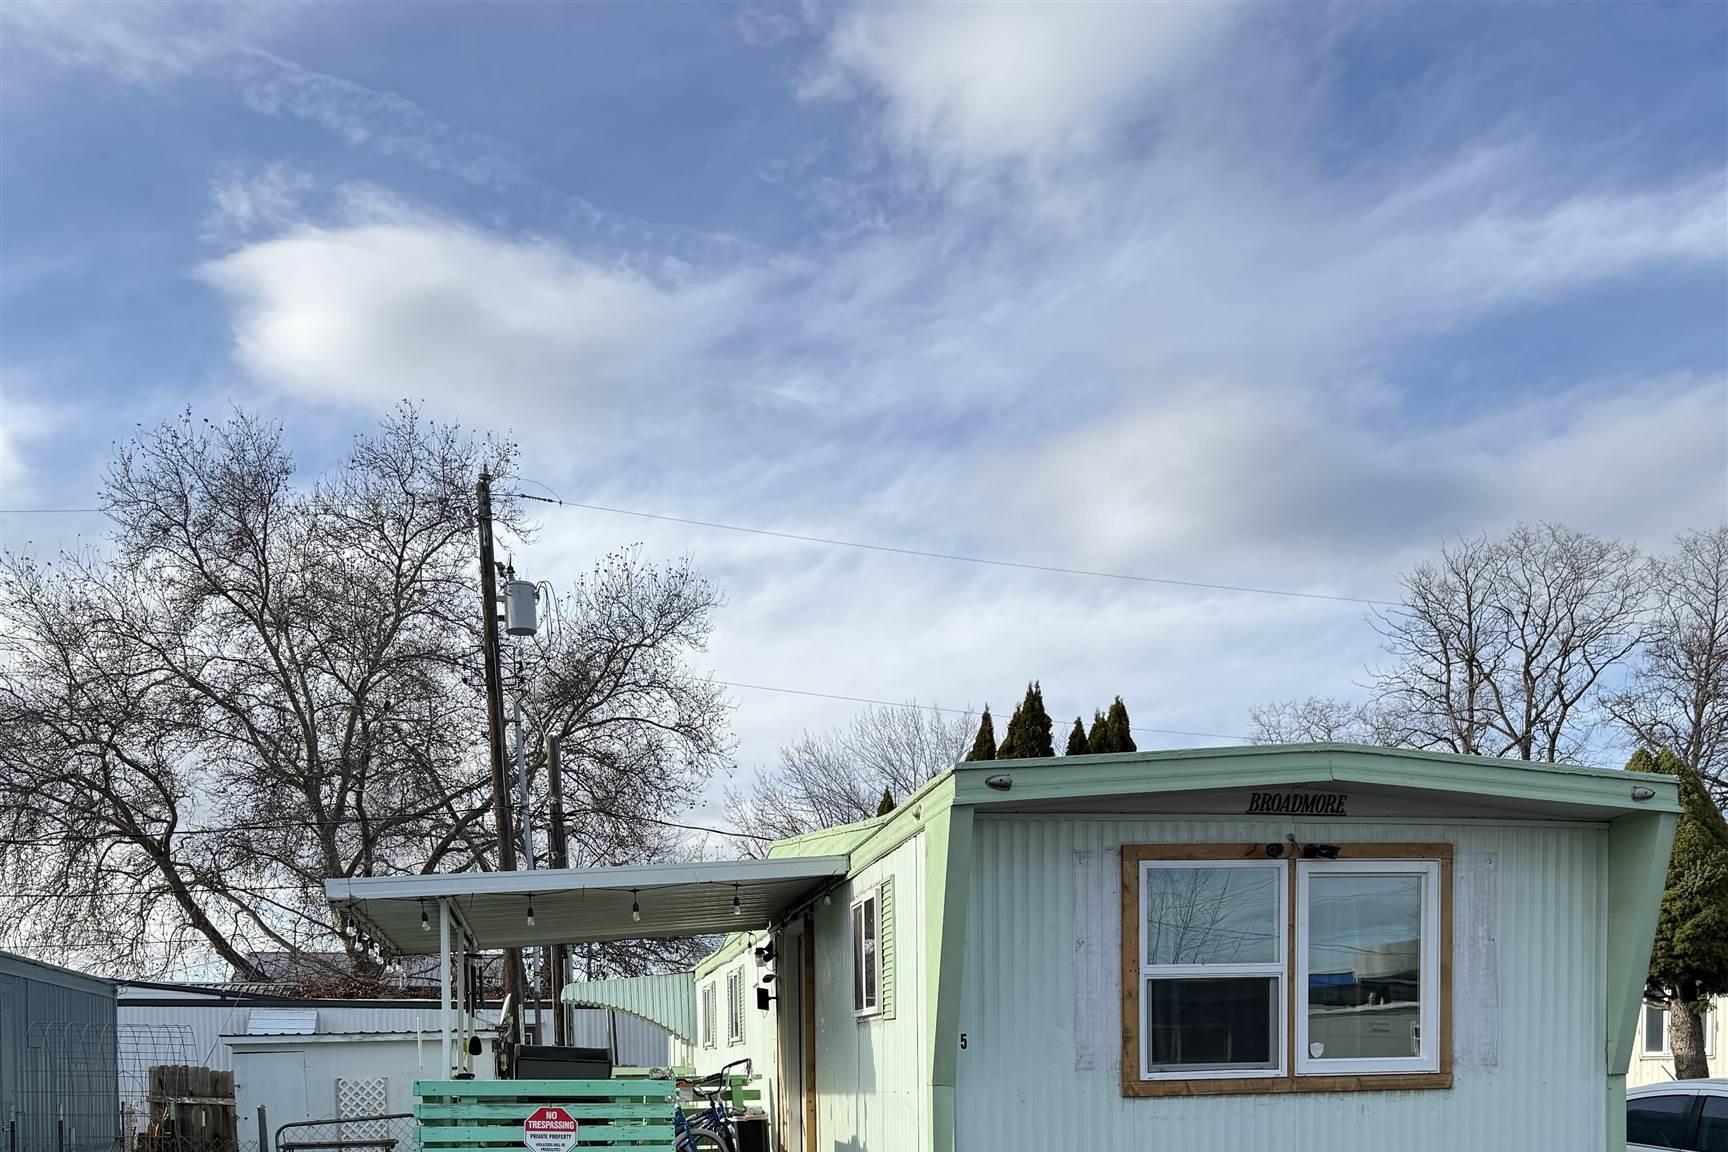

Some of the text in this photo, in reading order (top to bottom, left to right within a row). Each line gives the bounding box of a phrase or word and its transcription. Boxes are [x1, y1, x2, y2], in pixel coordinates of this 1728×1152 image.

[1248, 792, 1348, 814] BROADMORE
[960, 1033, 968, 1050] 5
[545, 1111, 558, 1120] NO
[528, 1120, 575, 1130] TRESPASSING
